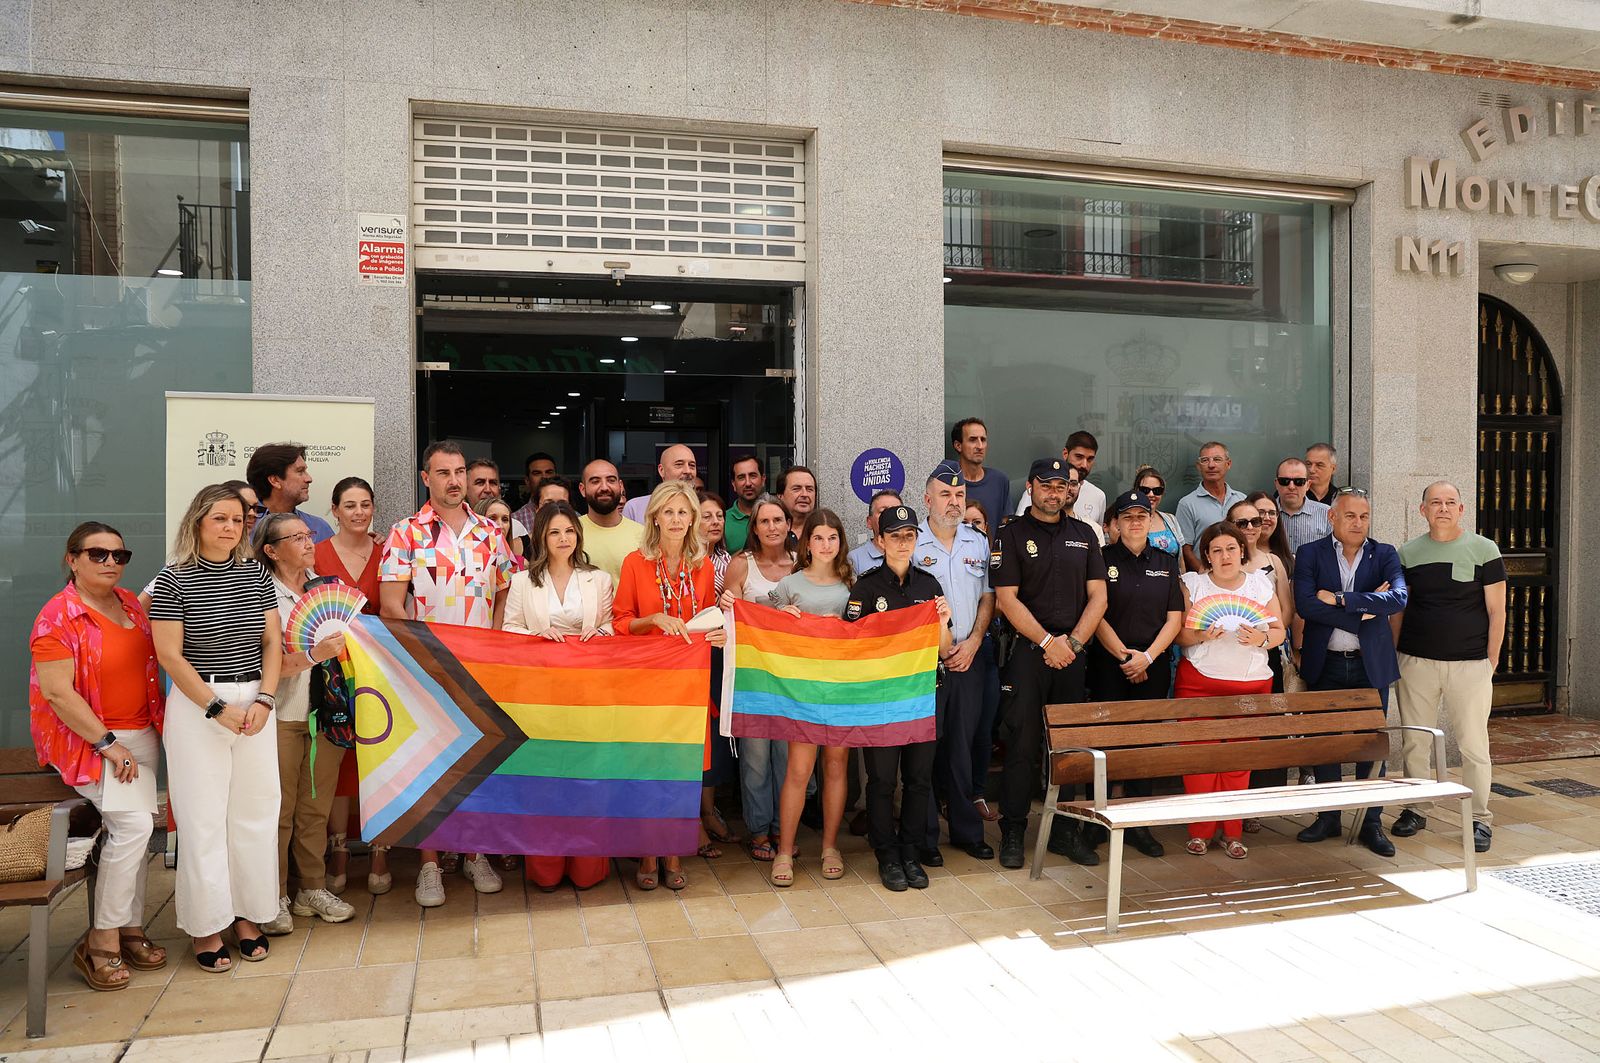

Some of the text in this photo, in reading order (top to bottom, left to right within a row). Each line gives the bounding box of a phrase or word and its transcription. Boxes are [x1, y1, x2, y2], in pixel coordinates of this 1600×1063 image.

[361, 226, 403, 234] verisure
[361, 243, 404, 254] Alarma
[1395, 235, 1465, 275] N11
[864, 463, 891, 471] MACHISTA
[863, 475, 891, 486] UNIDAS
